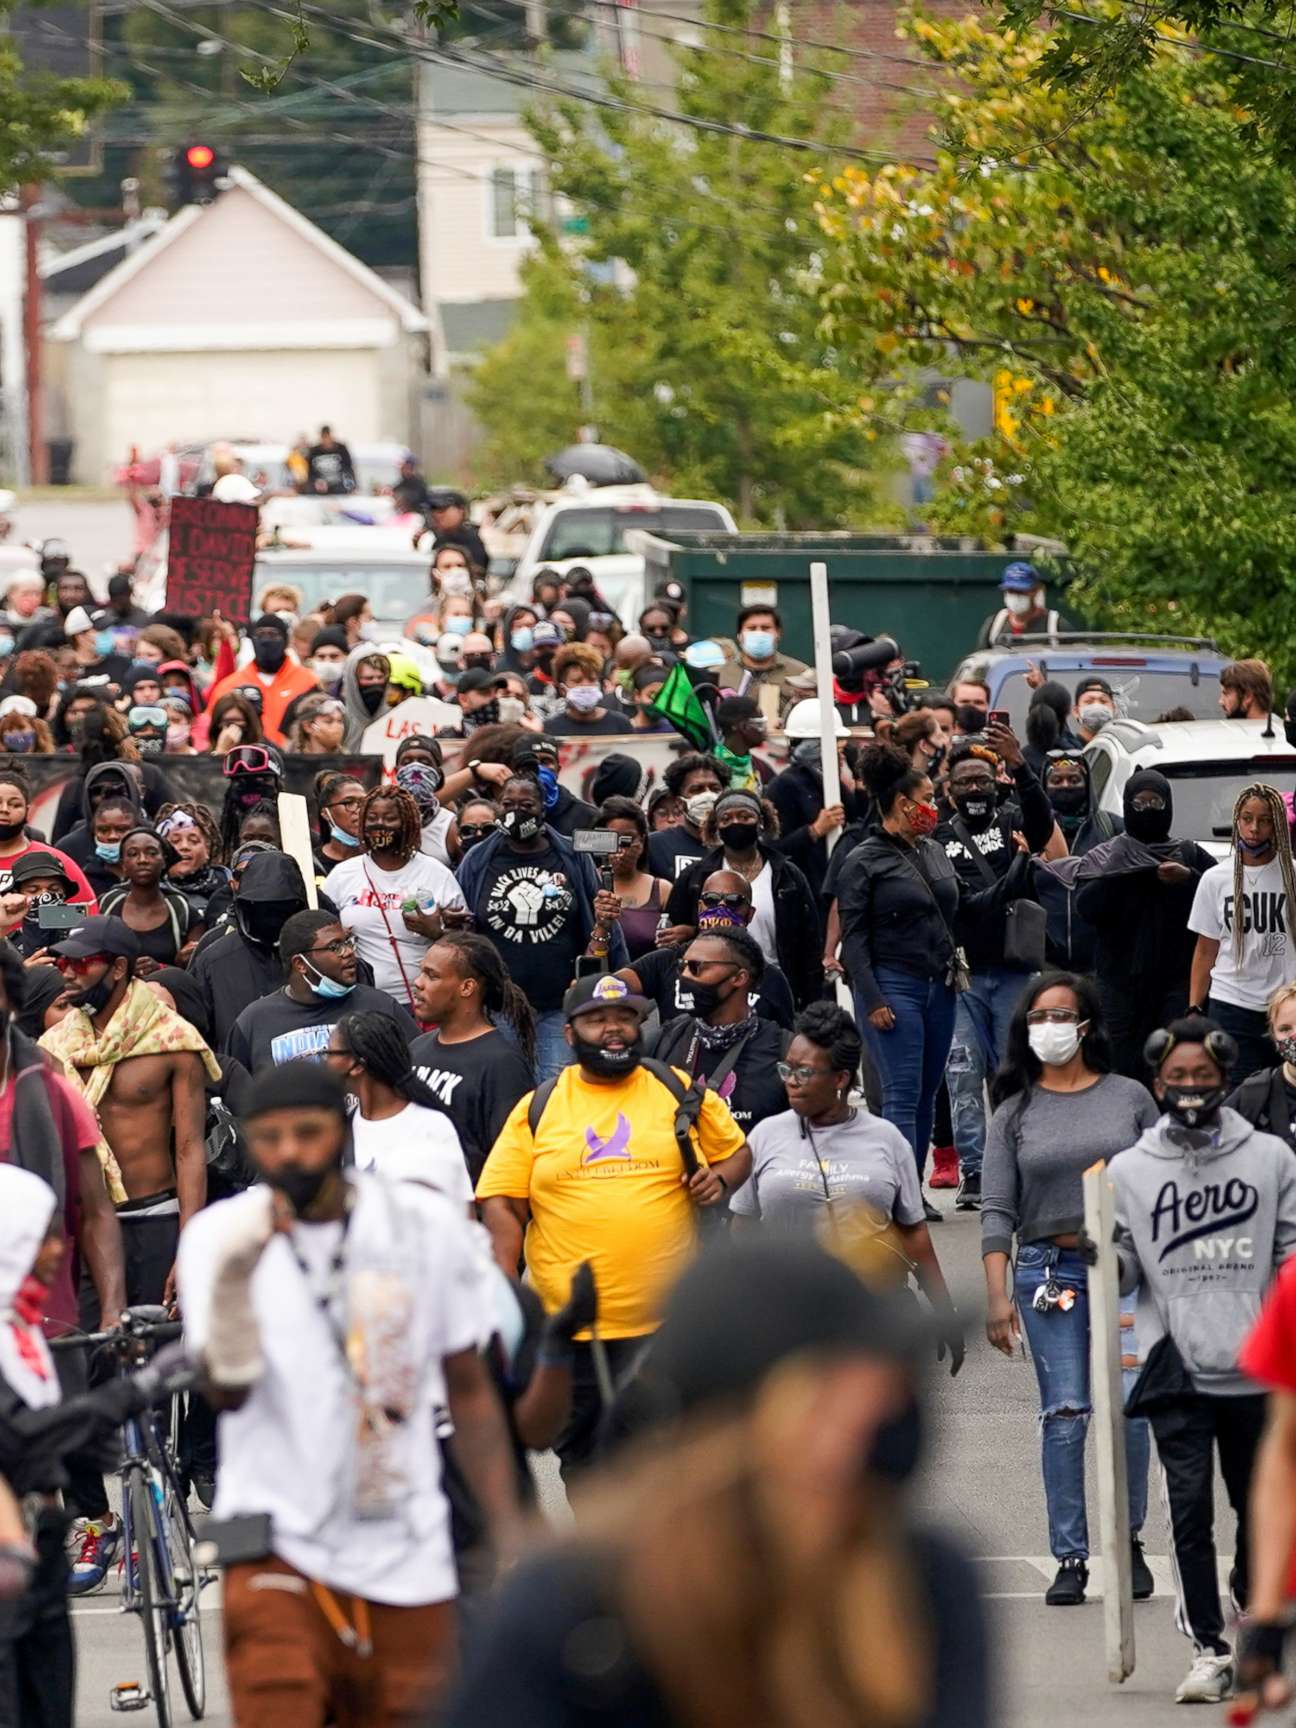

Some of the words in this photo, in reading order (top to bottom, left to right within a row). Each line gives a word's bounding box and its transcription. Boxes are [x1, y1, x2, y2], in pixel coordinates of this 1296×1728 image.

[488, 915, 506, 930] IN
[504, 926, 523, 943] DA
[1263, 933, 1287, 957] 12
[1152, 1177, 1257, 1243] Aero
[1193, 1237, 1253, 1260] NYC
